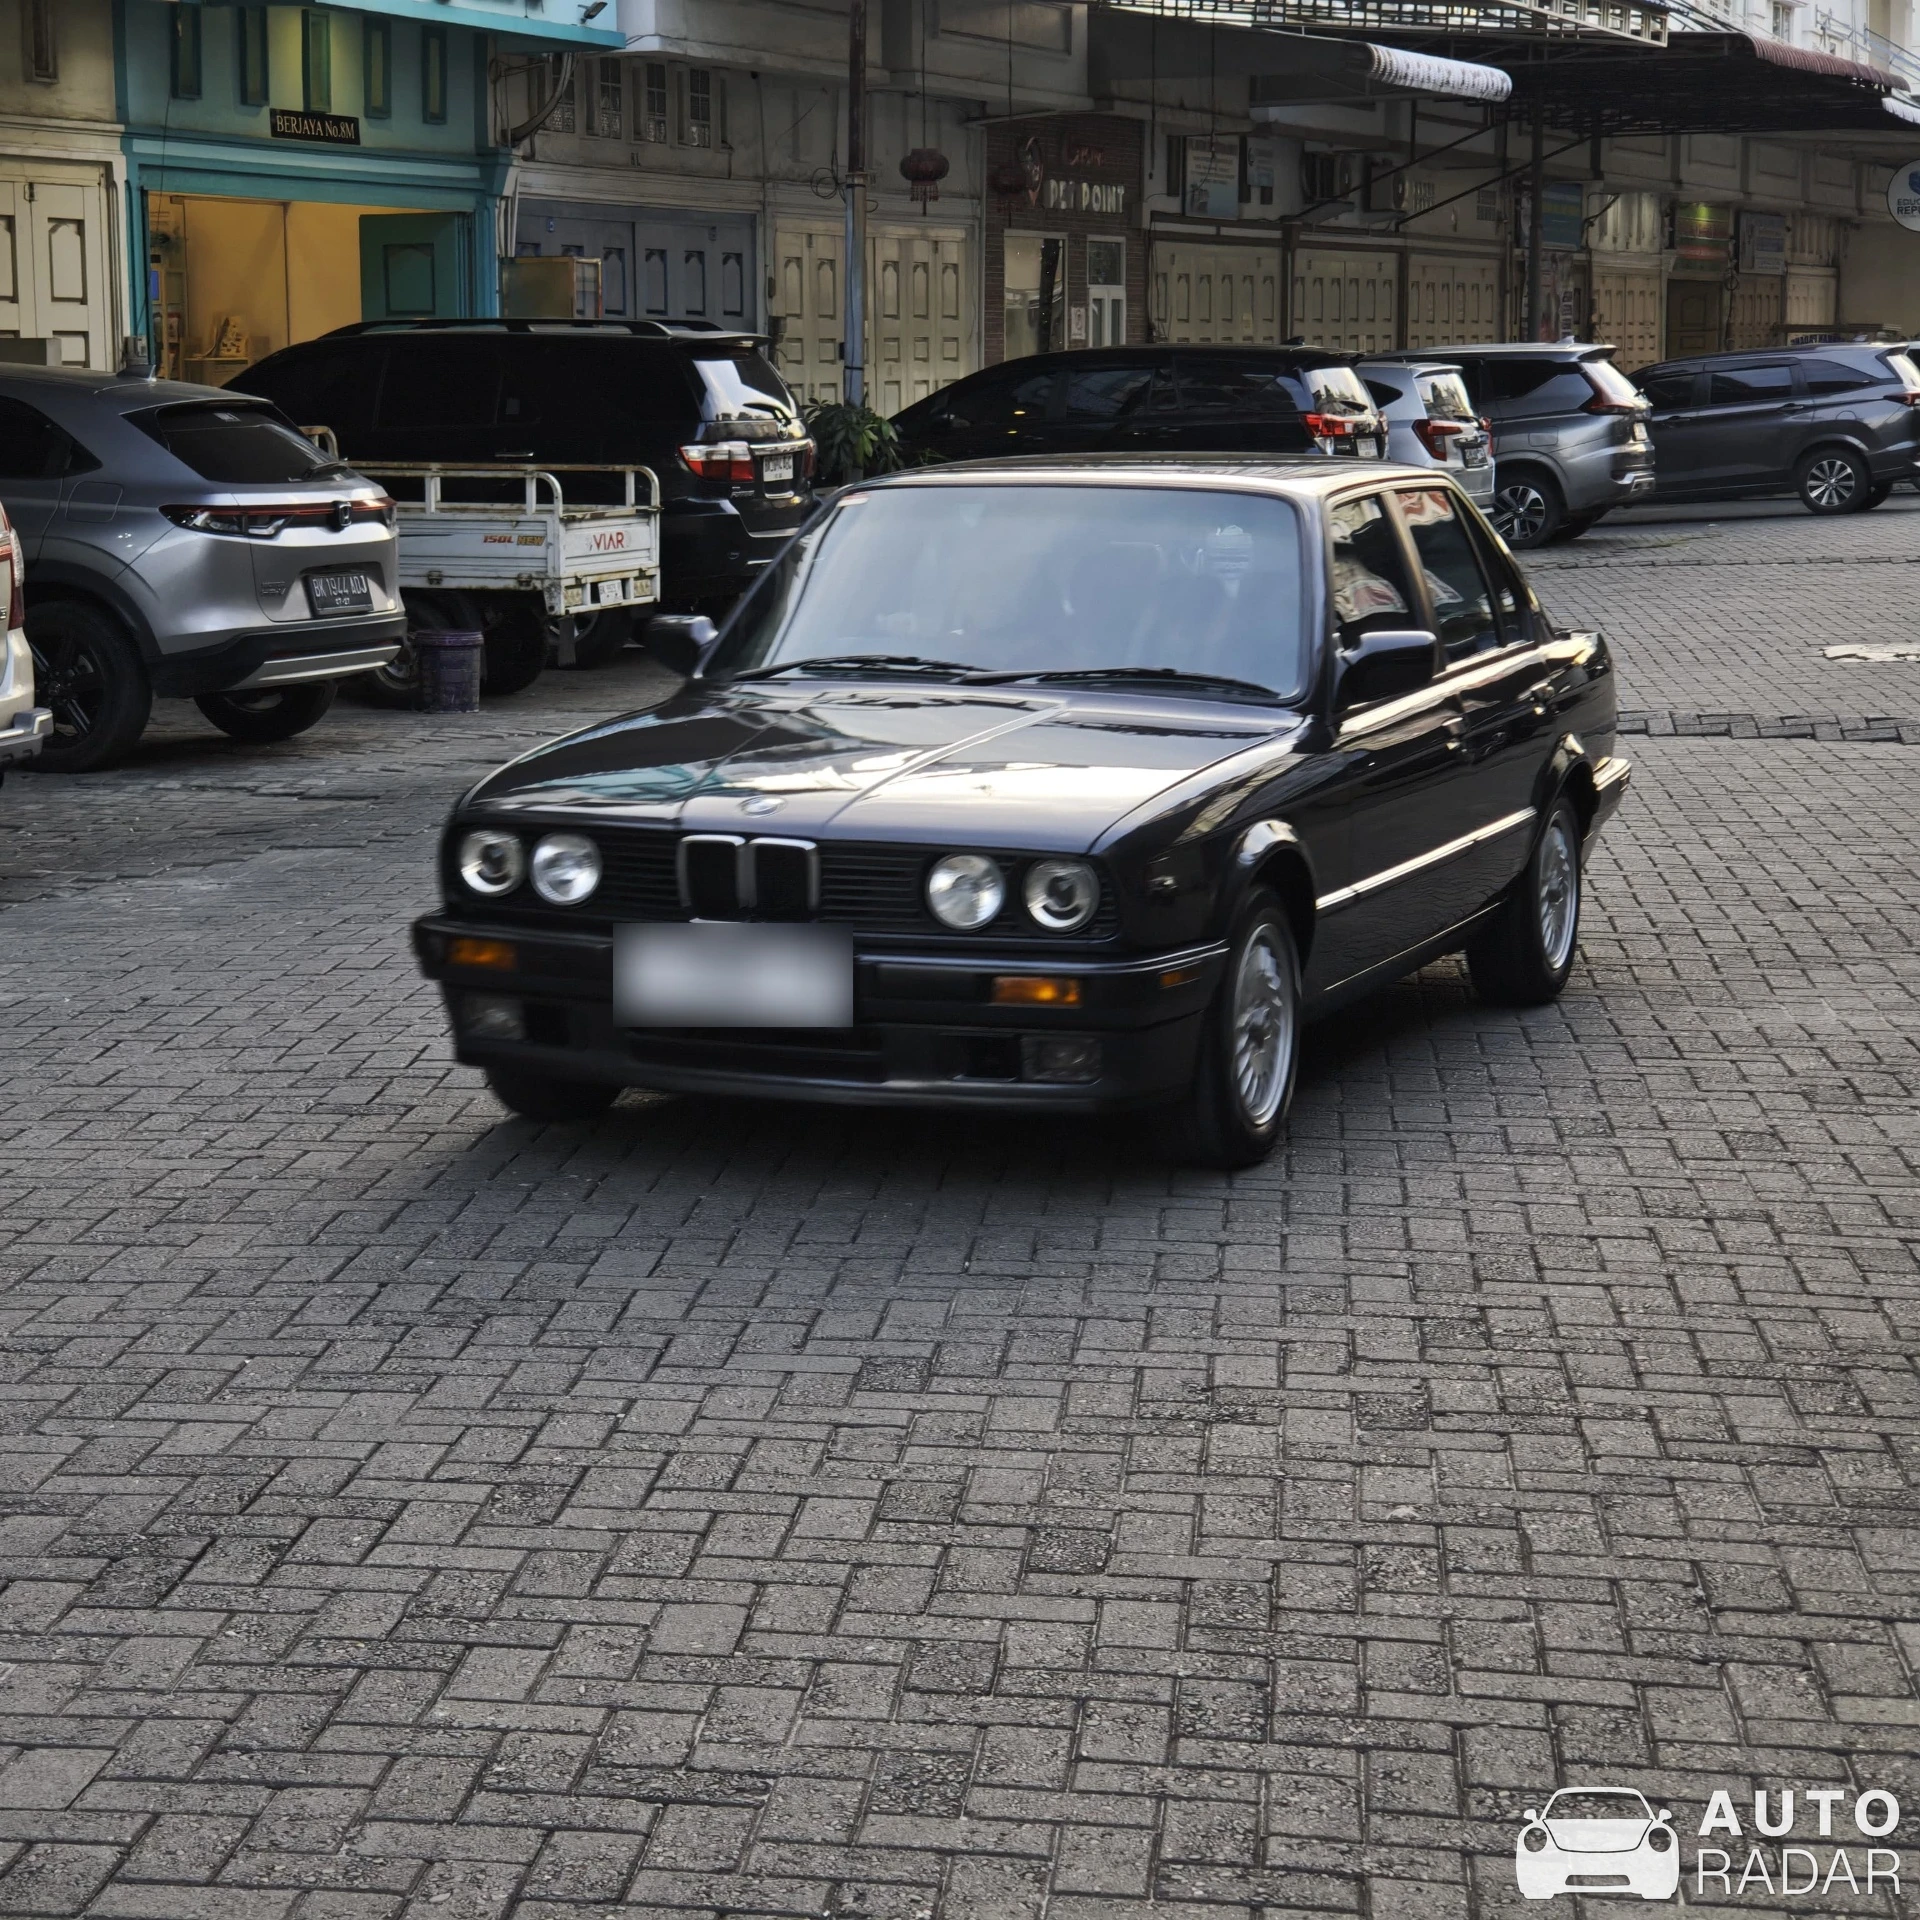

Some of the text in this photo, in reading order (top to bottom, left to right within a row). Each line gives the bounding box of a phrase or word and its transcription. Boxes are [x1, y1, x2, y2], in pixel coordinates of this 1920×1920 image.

[276, 115, 355, 139] BERJAYA No.8M
[1049, 178, 1125, 213] PET POINT
[593, 531, 625, 551] VIAR
[312, 575, 367, 598] BK 1944 ADJ
